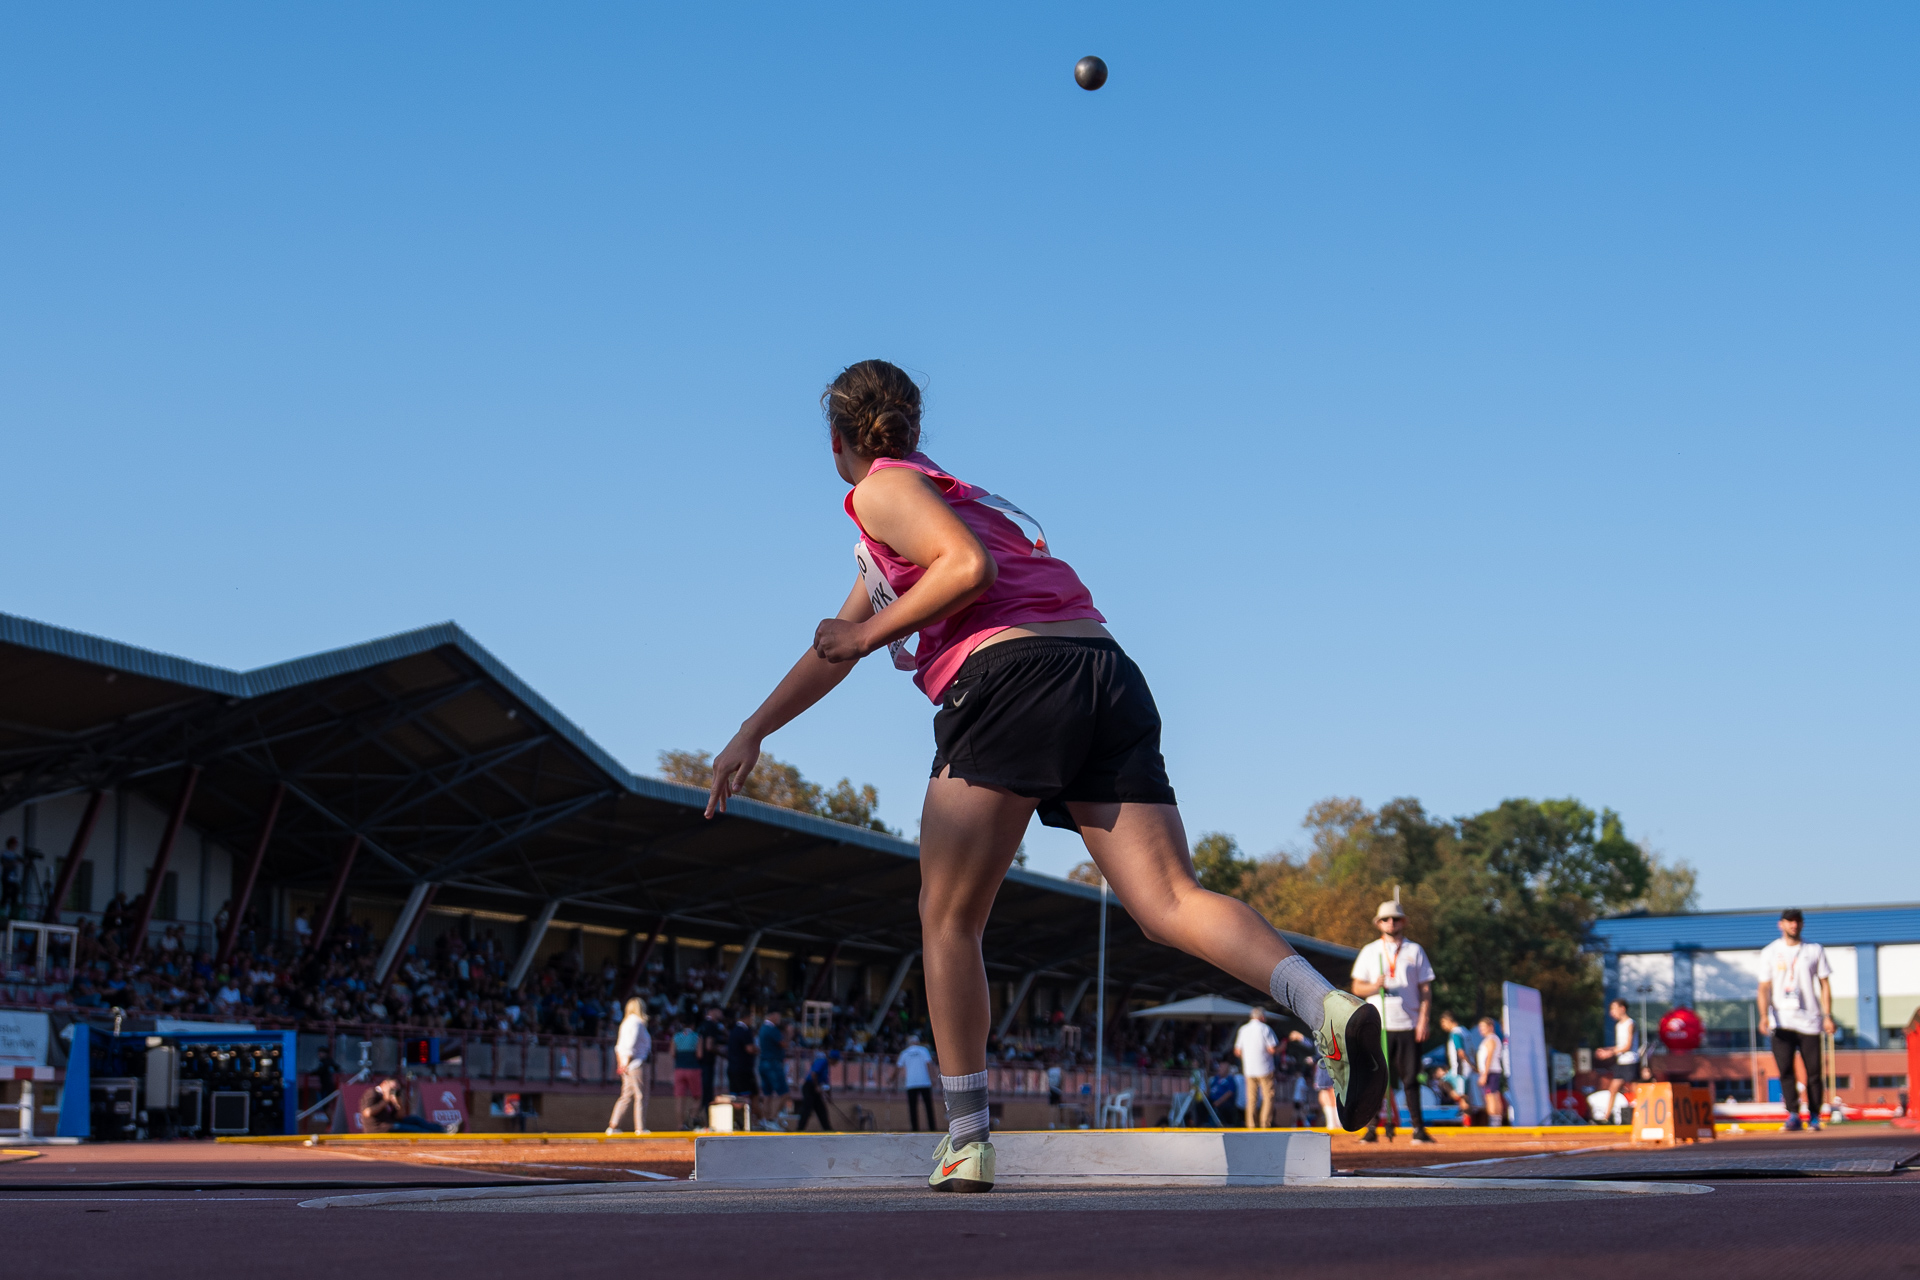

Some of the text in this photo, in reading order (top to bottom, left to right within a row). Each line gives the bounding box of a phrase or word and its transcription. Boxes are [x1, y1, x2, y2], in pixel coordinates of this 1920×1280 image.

[1641, 1098, 1666, 1125] 10
[1674, 1097, 1693, 1125] 10
[1694, 1101, 1711, 1125] 12
